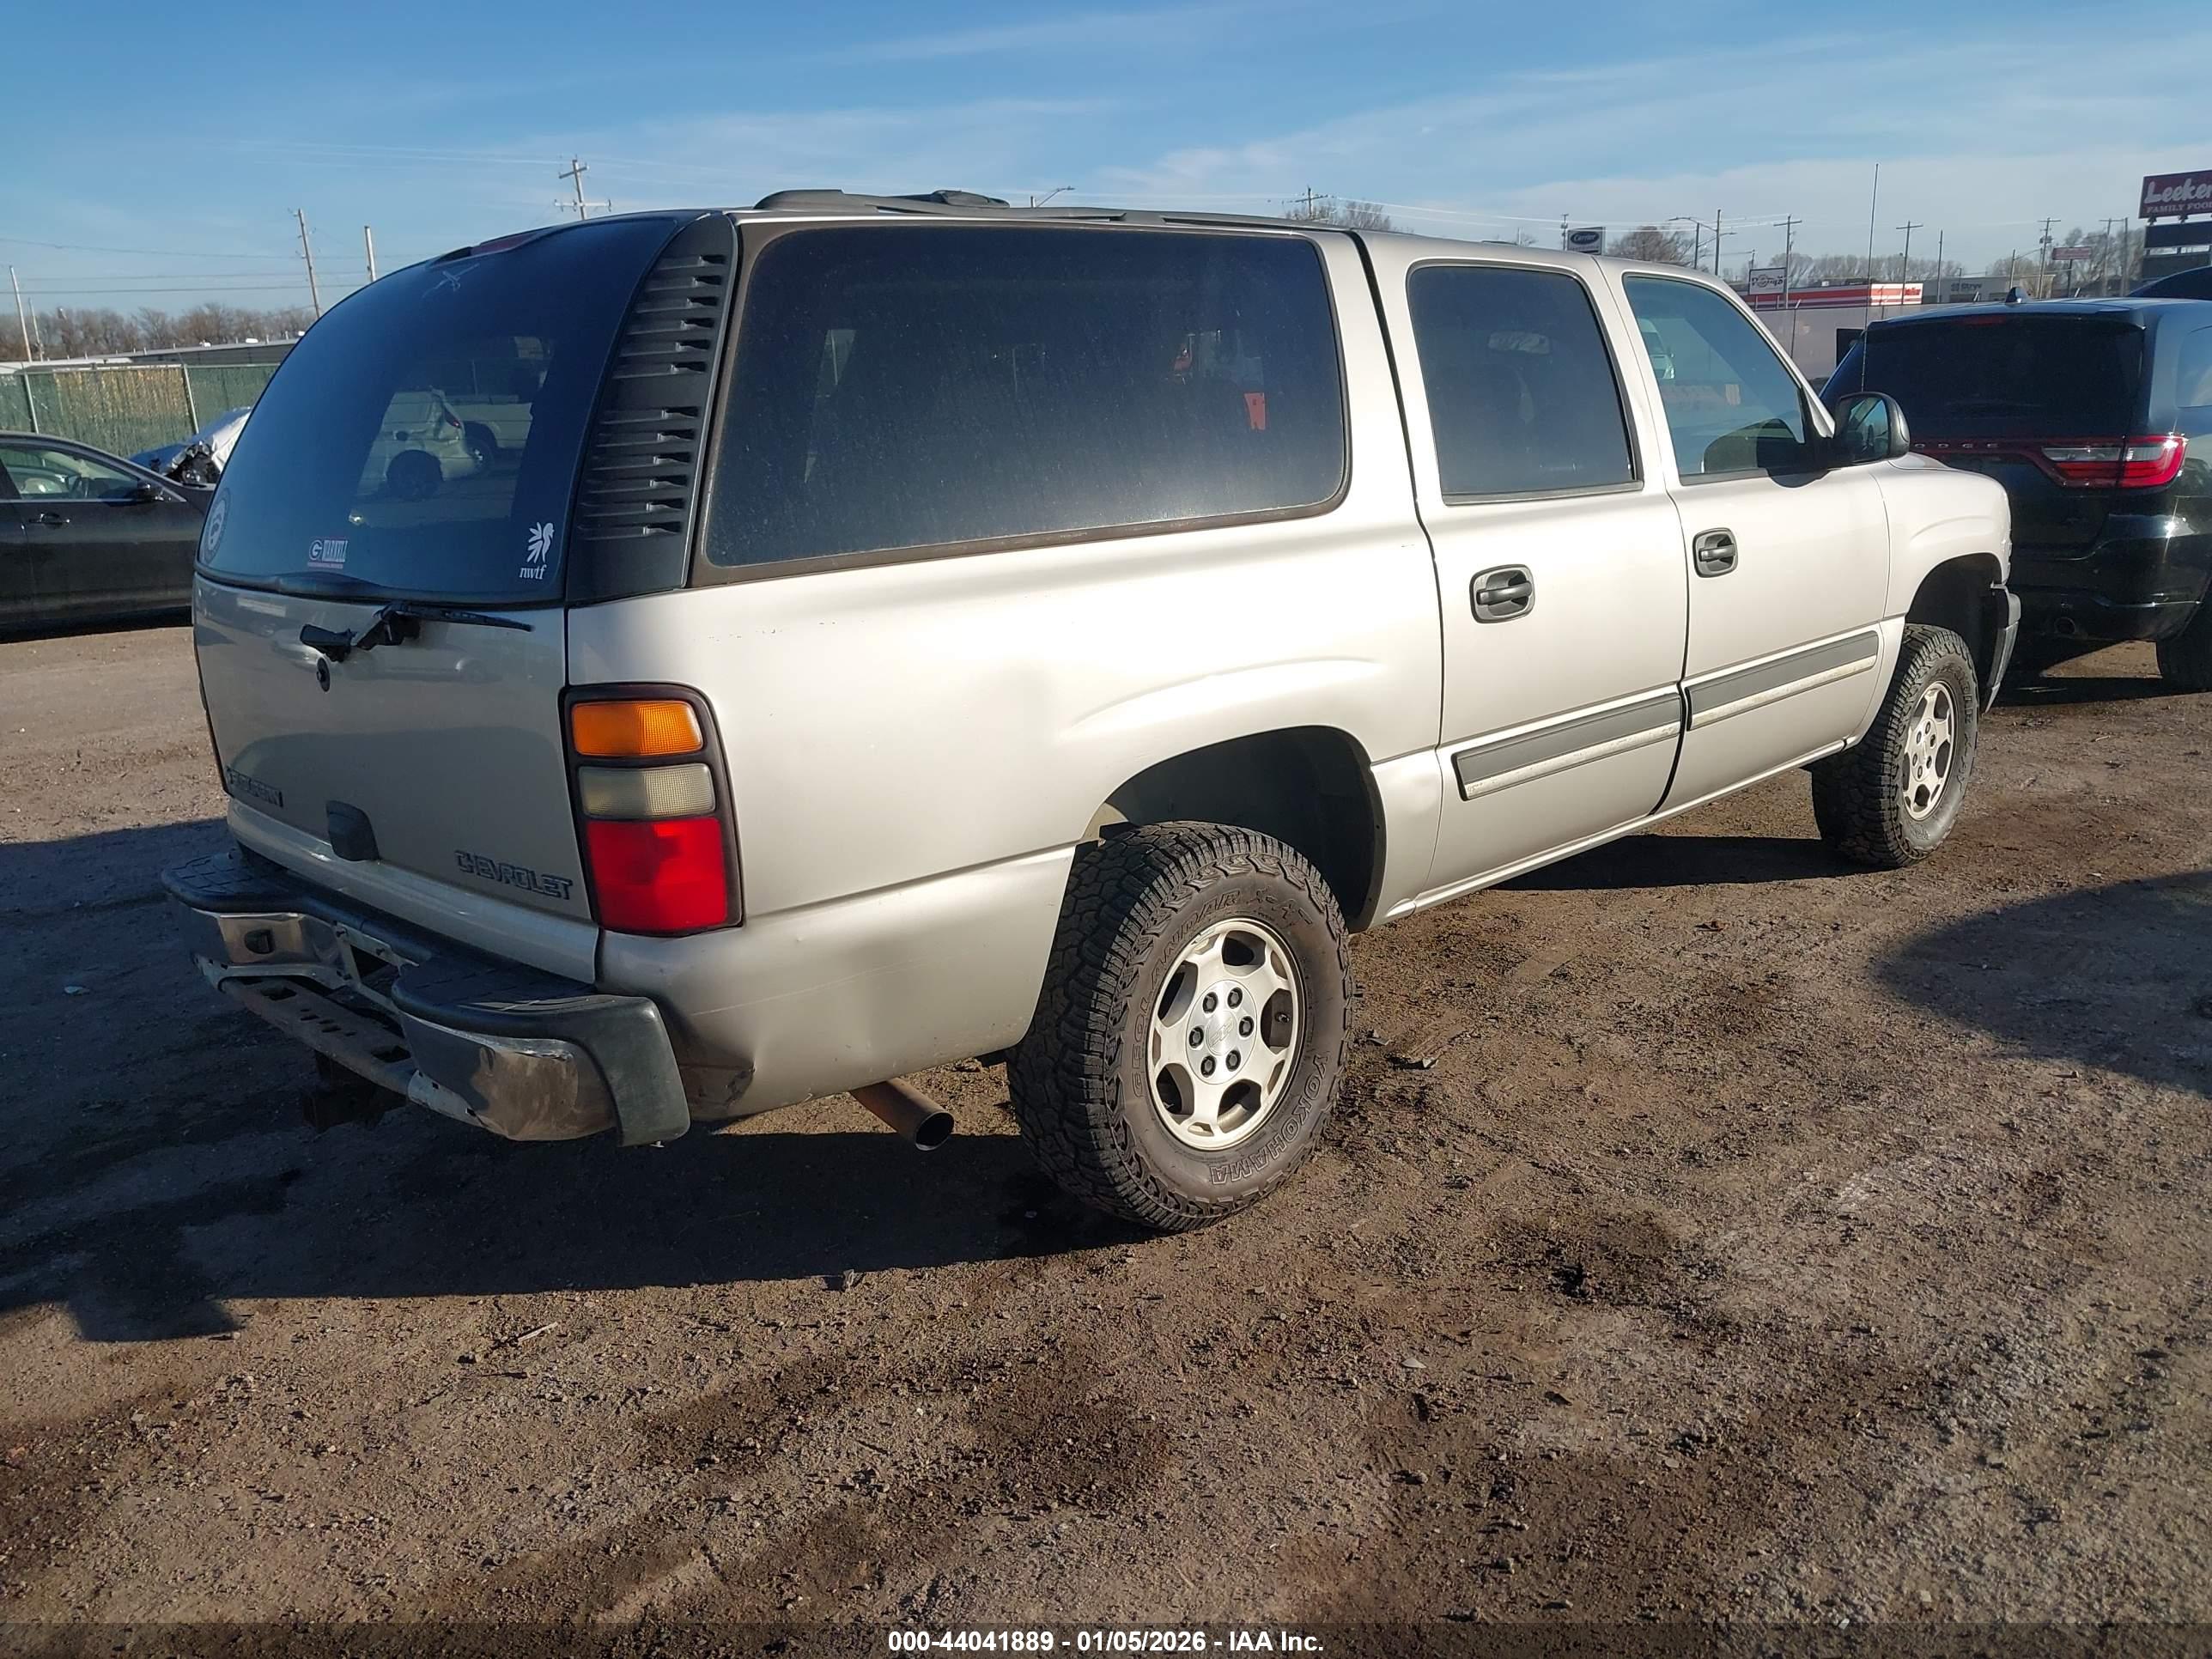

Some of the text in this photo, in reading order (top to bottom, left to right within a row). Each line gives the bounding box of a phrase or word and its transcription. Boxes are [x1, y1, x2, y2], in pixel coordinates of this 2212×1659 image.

[2147, 204, 2185, 213] FAMILY
[519, 564, 547, 580] nwtf
[454, 850, 573, 900] CHEVROLET
[1132, 890, 1242, 1097] GEOLANDAR
[1209, 1050, 1331, 1185] YOKOHAMA
